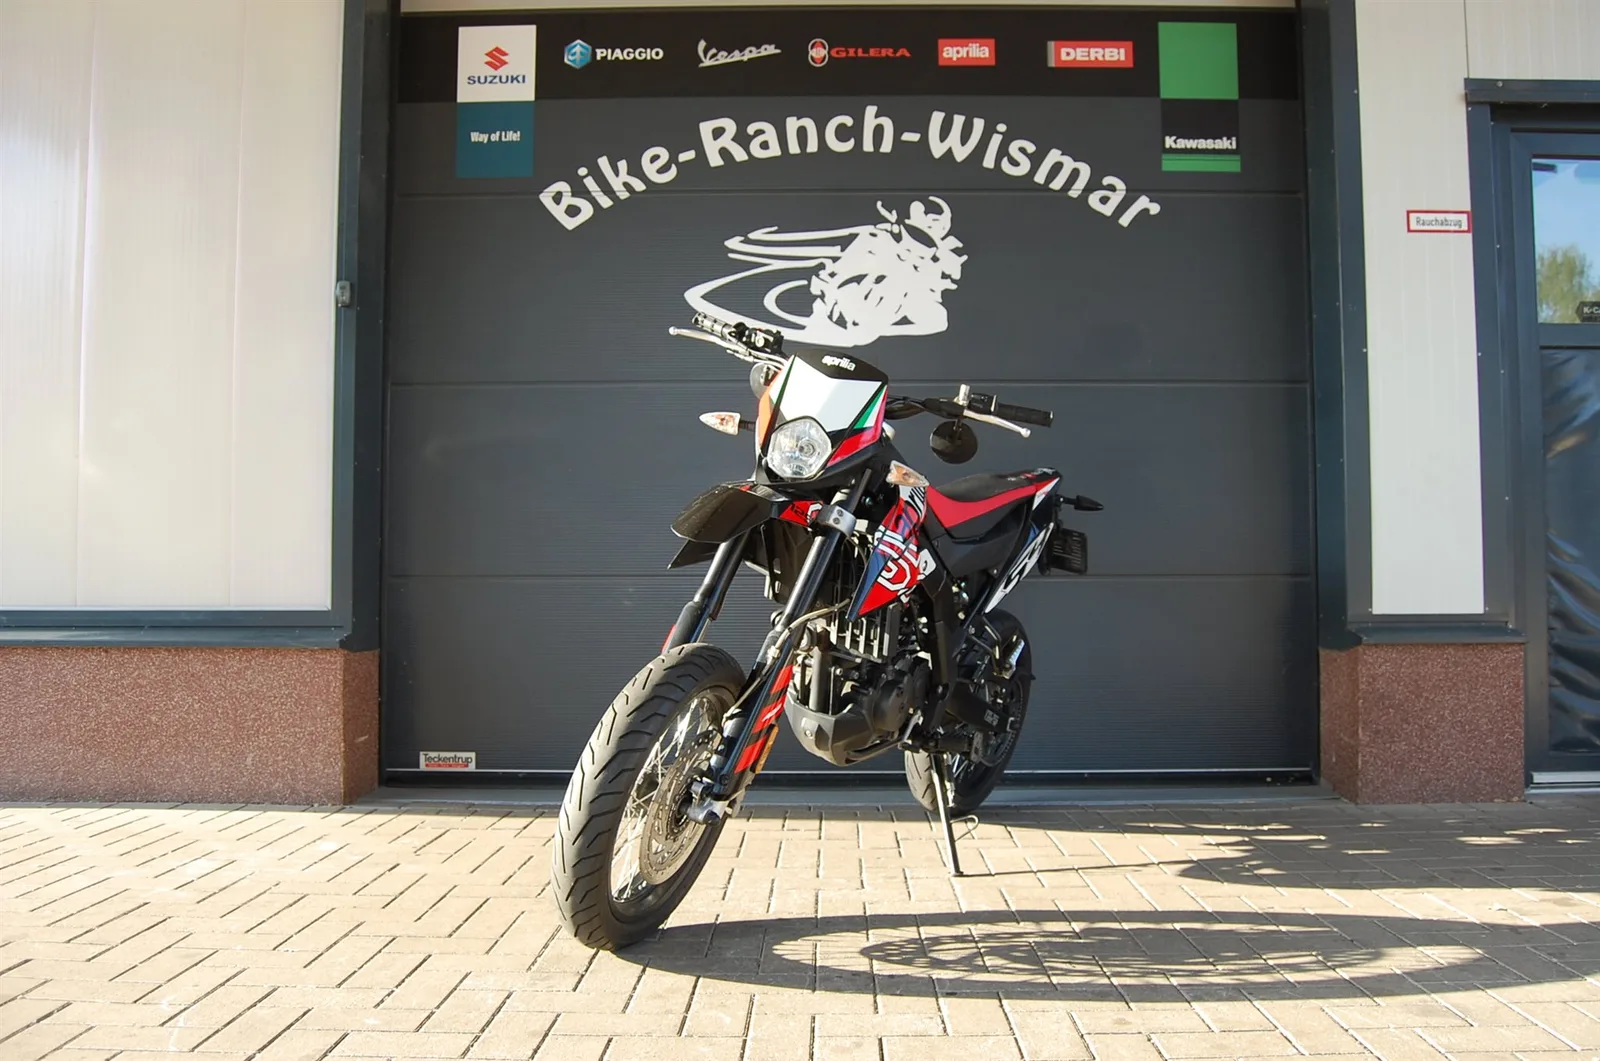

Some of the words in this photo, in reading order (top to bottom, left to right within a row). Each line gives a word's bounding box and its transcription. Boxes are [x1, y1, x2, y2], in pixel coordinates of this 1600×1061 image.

[595, 47, 664, 61] PIAGGIO
[697, 39, 782, 67] Vespa
[830, 46, 911, 58] GILERA
[942, 43, 989, 60] aprilia
[1060, 47, 1126, 61] DERBI
[467, 75, 526, 86] SUZUKI
[470, 131, 489, 144] Way
[490, 130, 500, 142] of
[501, 130, 521, 142] Life!
[1164, 136, 1237, 150] Kawasaki
[1415, 216, 1463, 229] Rauchabzug
[822, 355, 856, 371] aprilia
[422, 752, 473, 764] Teckentrup
